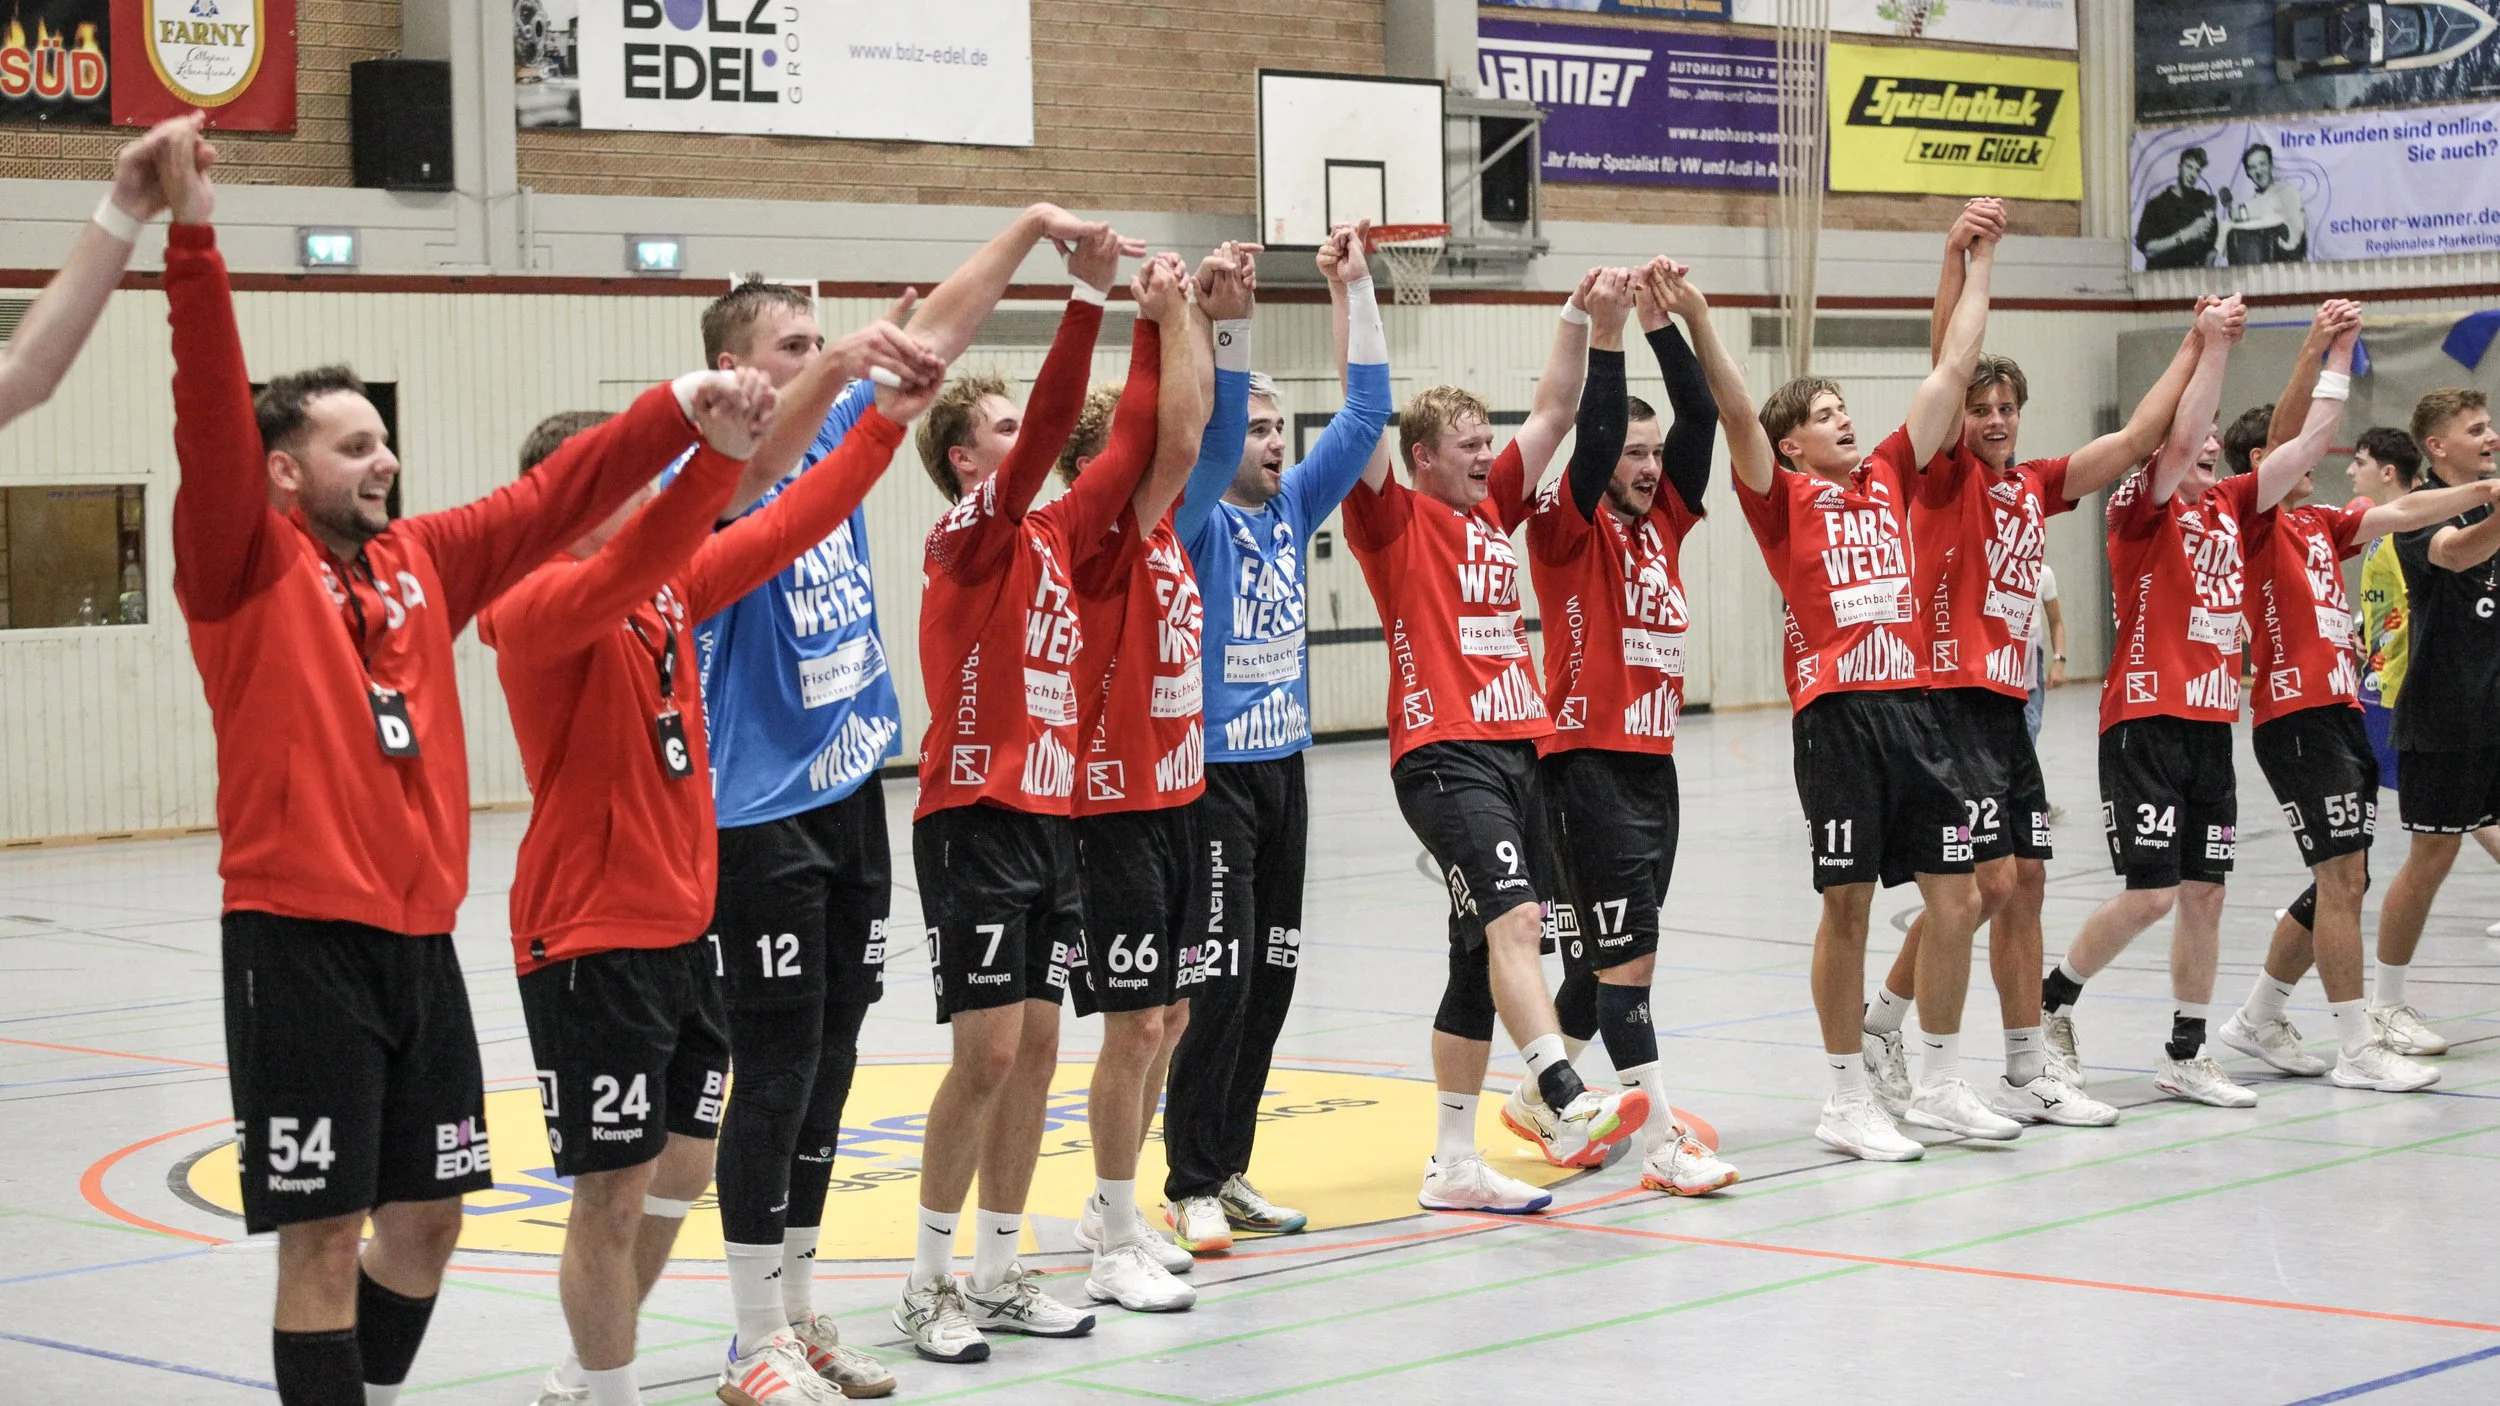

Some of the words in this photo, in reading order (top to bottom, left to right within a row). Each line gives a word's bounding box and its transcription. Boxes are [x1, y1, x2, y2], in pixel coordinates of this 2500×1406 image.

[159, 19, 250, 47] FARNY
[0, 38, 105, 97] SÜD
[784, 6, 803, 104] GROU
[848, 42, 989, 67] www.bolz-edel.de
[624, 43, 779, 103] EDEL
[1668, 61, 1732, 77] AUTOHAUS
[1735, 65, 1765, 79] RALF
[1864, 79, 2042, 126] Spielothek
[2281, 130, 2316, 149] Ihre
[2321, 125, 2389, 146] Kunden
[2393, 120, 2432, 141] sind
[2437, 117, 2498, 137] online.
[1919, 141, 1972, 161] zum
[1976, 137, 2042, 165] Glück
[2408, 144, 2436, 163] Sie
[2441, 138, 2498, 160] auch?
[1603, 153, 1660, 174] Spezialist
[1661, 156, 1678, 173] für
[1680, 157, 1702, 174] VW
[1702, 159, 1726, 175] und
[1726, 159, 1752, 177] Audi
[1754, 160, 1766, 177] in
[2330, 207, 2500, 234] schorer-wanner.de
[2366, 235, 2436, 253] Regionales
[2475, 597, 2496, 618] C
[2191, 616, 2232, 636] Fisach
[1227, 648, 1293, 666] Fischbach
[1624, 638, 1680, 657] Fiscach
[1836, 624, 1916, 683] WALDNER
[802, 661, 861, 687] Fischba
[378, 714, 411, 749] D
[2136, 803, 2177, 837] 34
[2324, 791, 2360, 827] 55
[1824, 819, 1853, 854] 11
[1970, 832, 1997, 845] empa
[2135, 835, 2170, 849] Kempa
[2330, 826, 2360, 839] Kempa
[1495, 840, 1519, 875] 9
[1818, 856, 1854, 868] Kempa
[1495, 876, 1529, 891] Kempa
[1592, 897, 1628, 935] 17
[975, 924, 1004, 967] 7
[1107, 933, 1159, 973] 66
[1598, 932, 1634, 948] Kempa
[756, 932, 802, 978] 12
[1204, 938, 1240, 977] 21
[967, 972, 1012, 986] Kempa
[1108, 976, 1149, 990] Kempa
[590, 1073, 651, 1124] 24
[267, 1116, 336, 1173] 54
[591, 1126, 643, 1144] Kempa
[267, 1174, 327, 1194] Kempa
